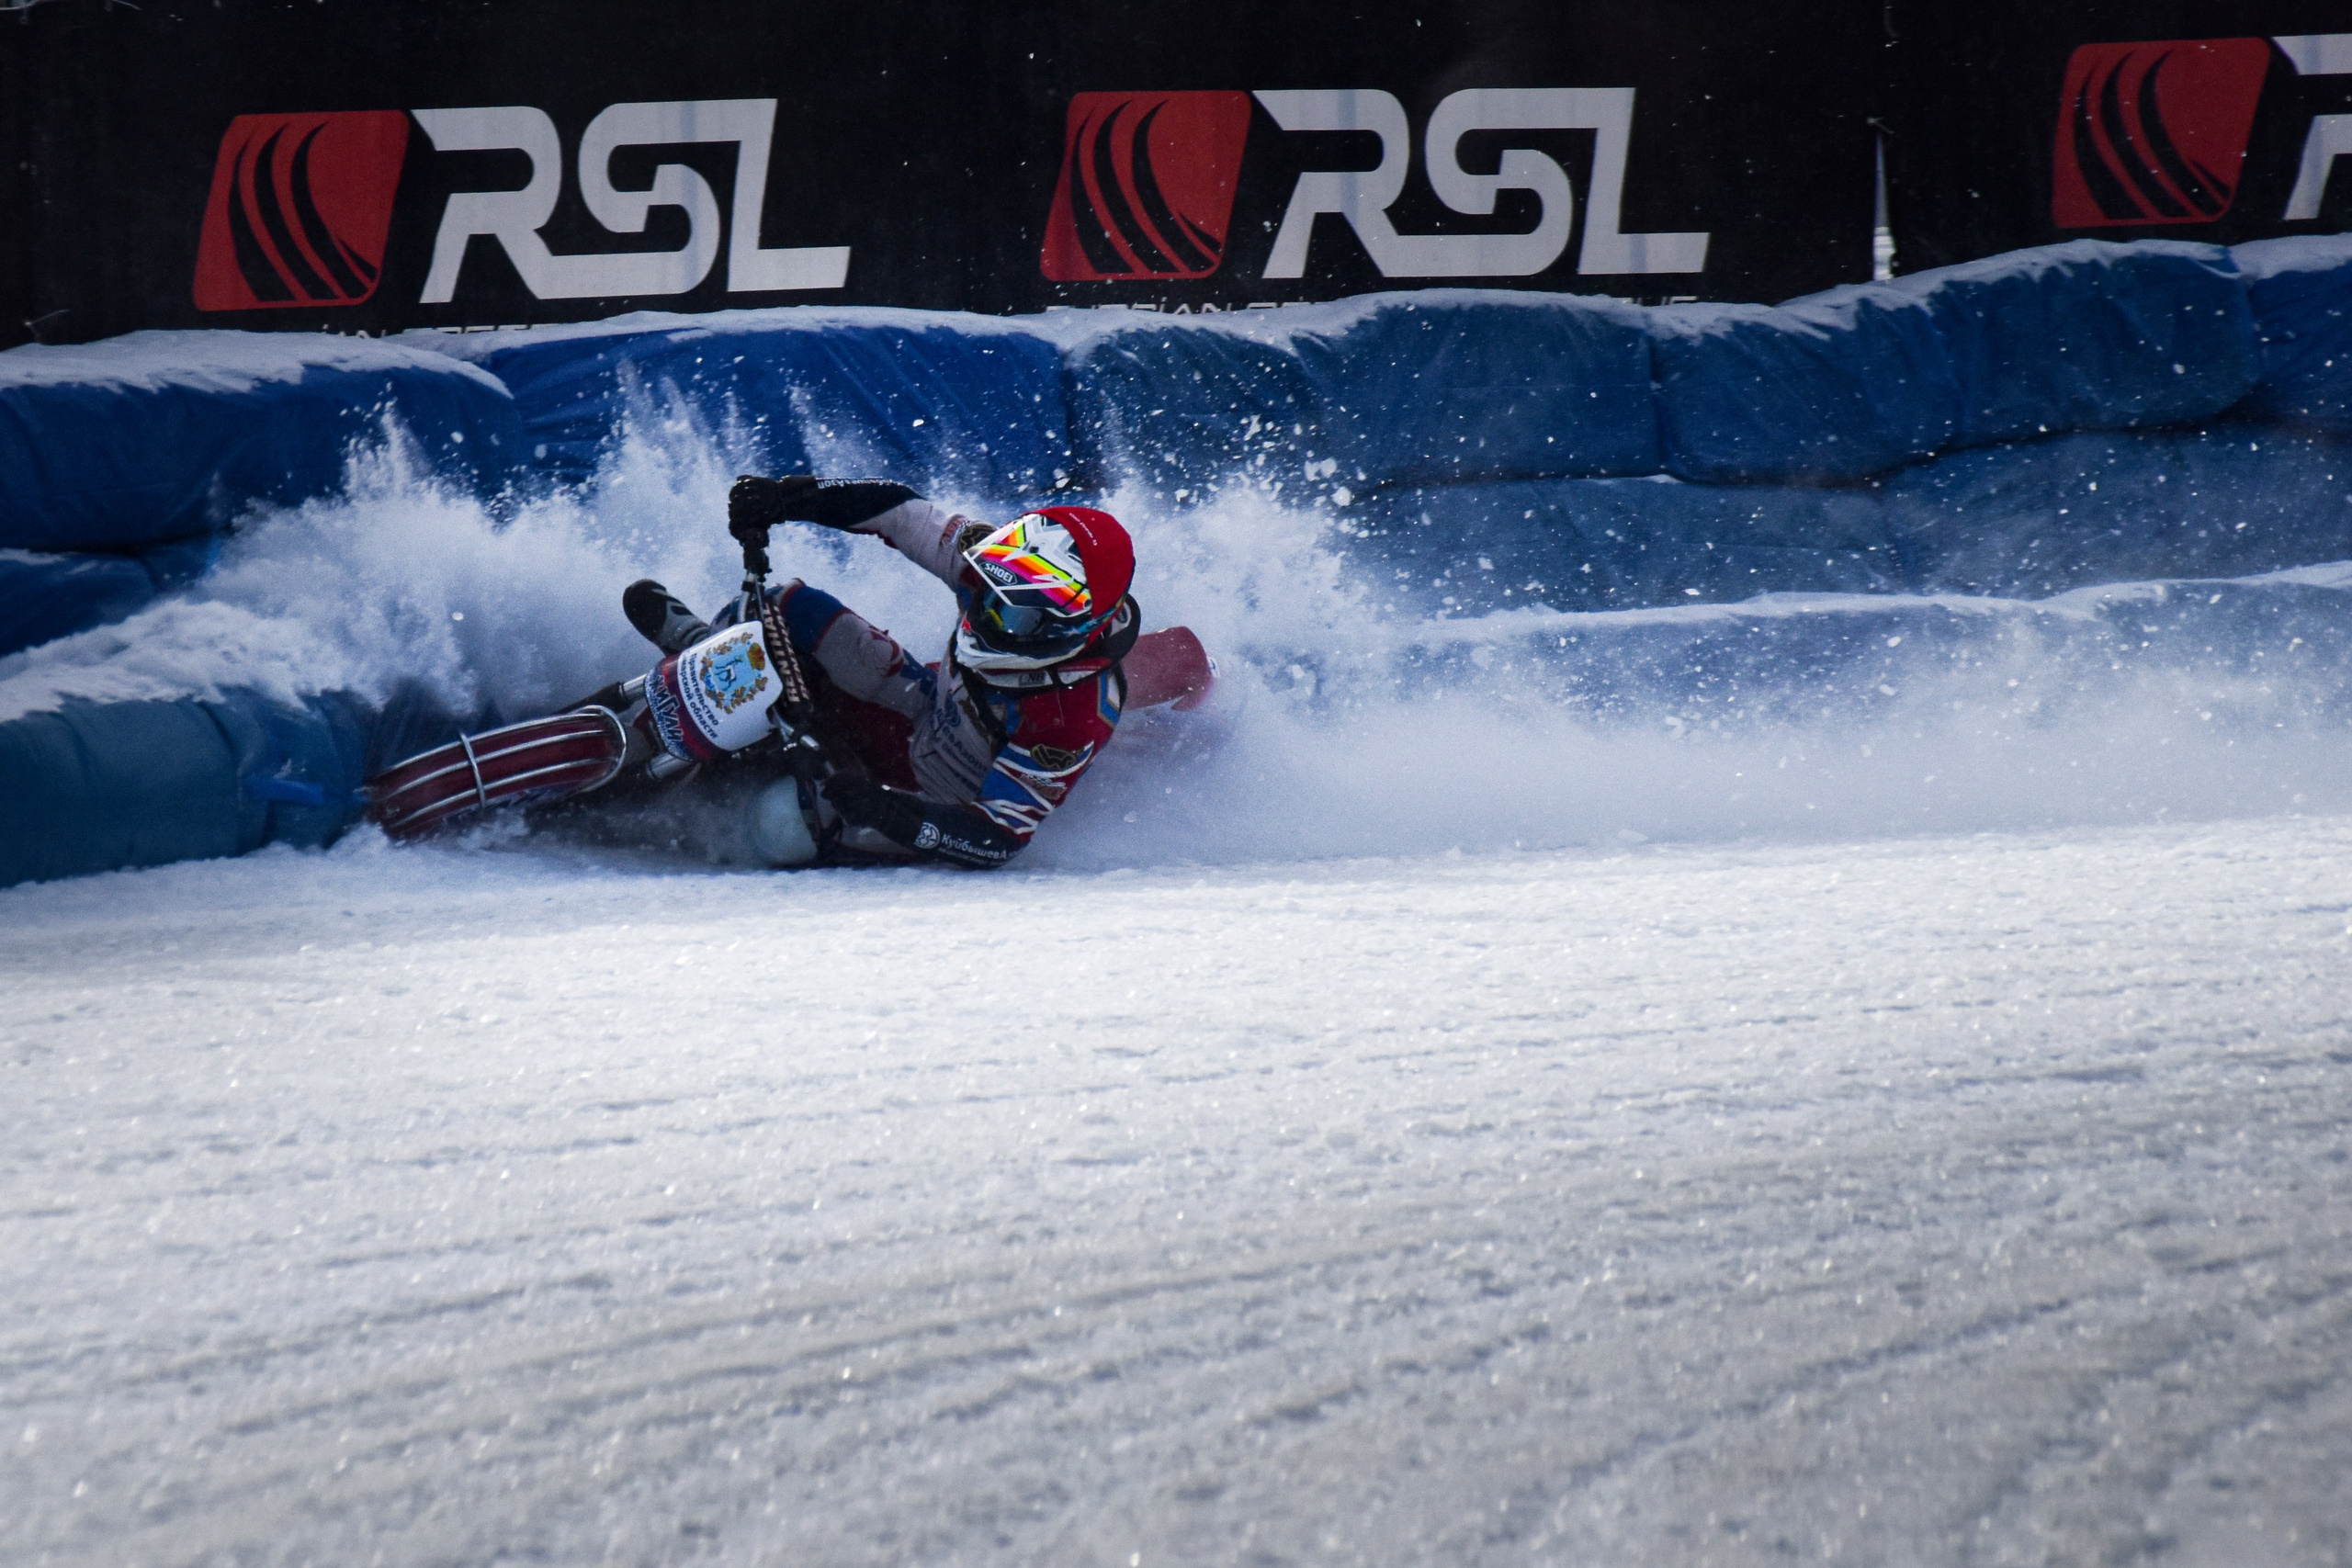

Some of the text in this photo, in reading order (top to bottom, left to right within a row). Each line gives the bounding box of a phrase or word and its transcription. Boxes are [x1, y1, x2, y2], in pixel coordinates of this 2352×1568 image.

[412, 97, 853, 304] RSL
[1253, 86, 1711, 279] RSL
[984, 561, 1013, 583] SHOEI
[763, 603, 800, 703] RENTHAL
[690, 701, 718, 739] области
